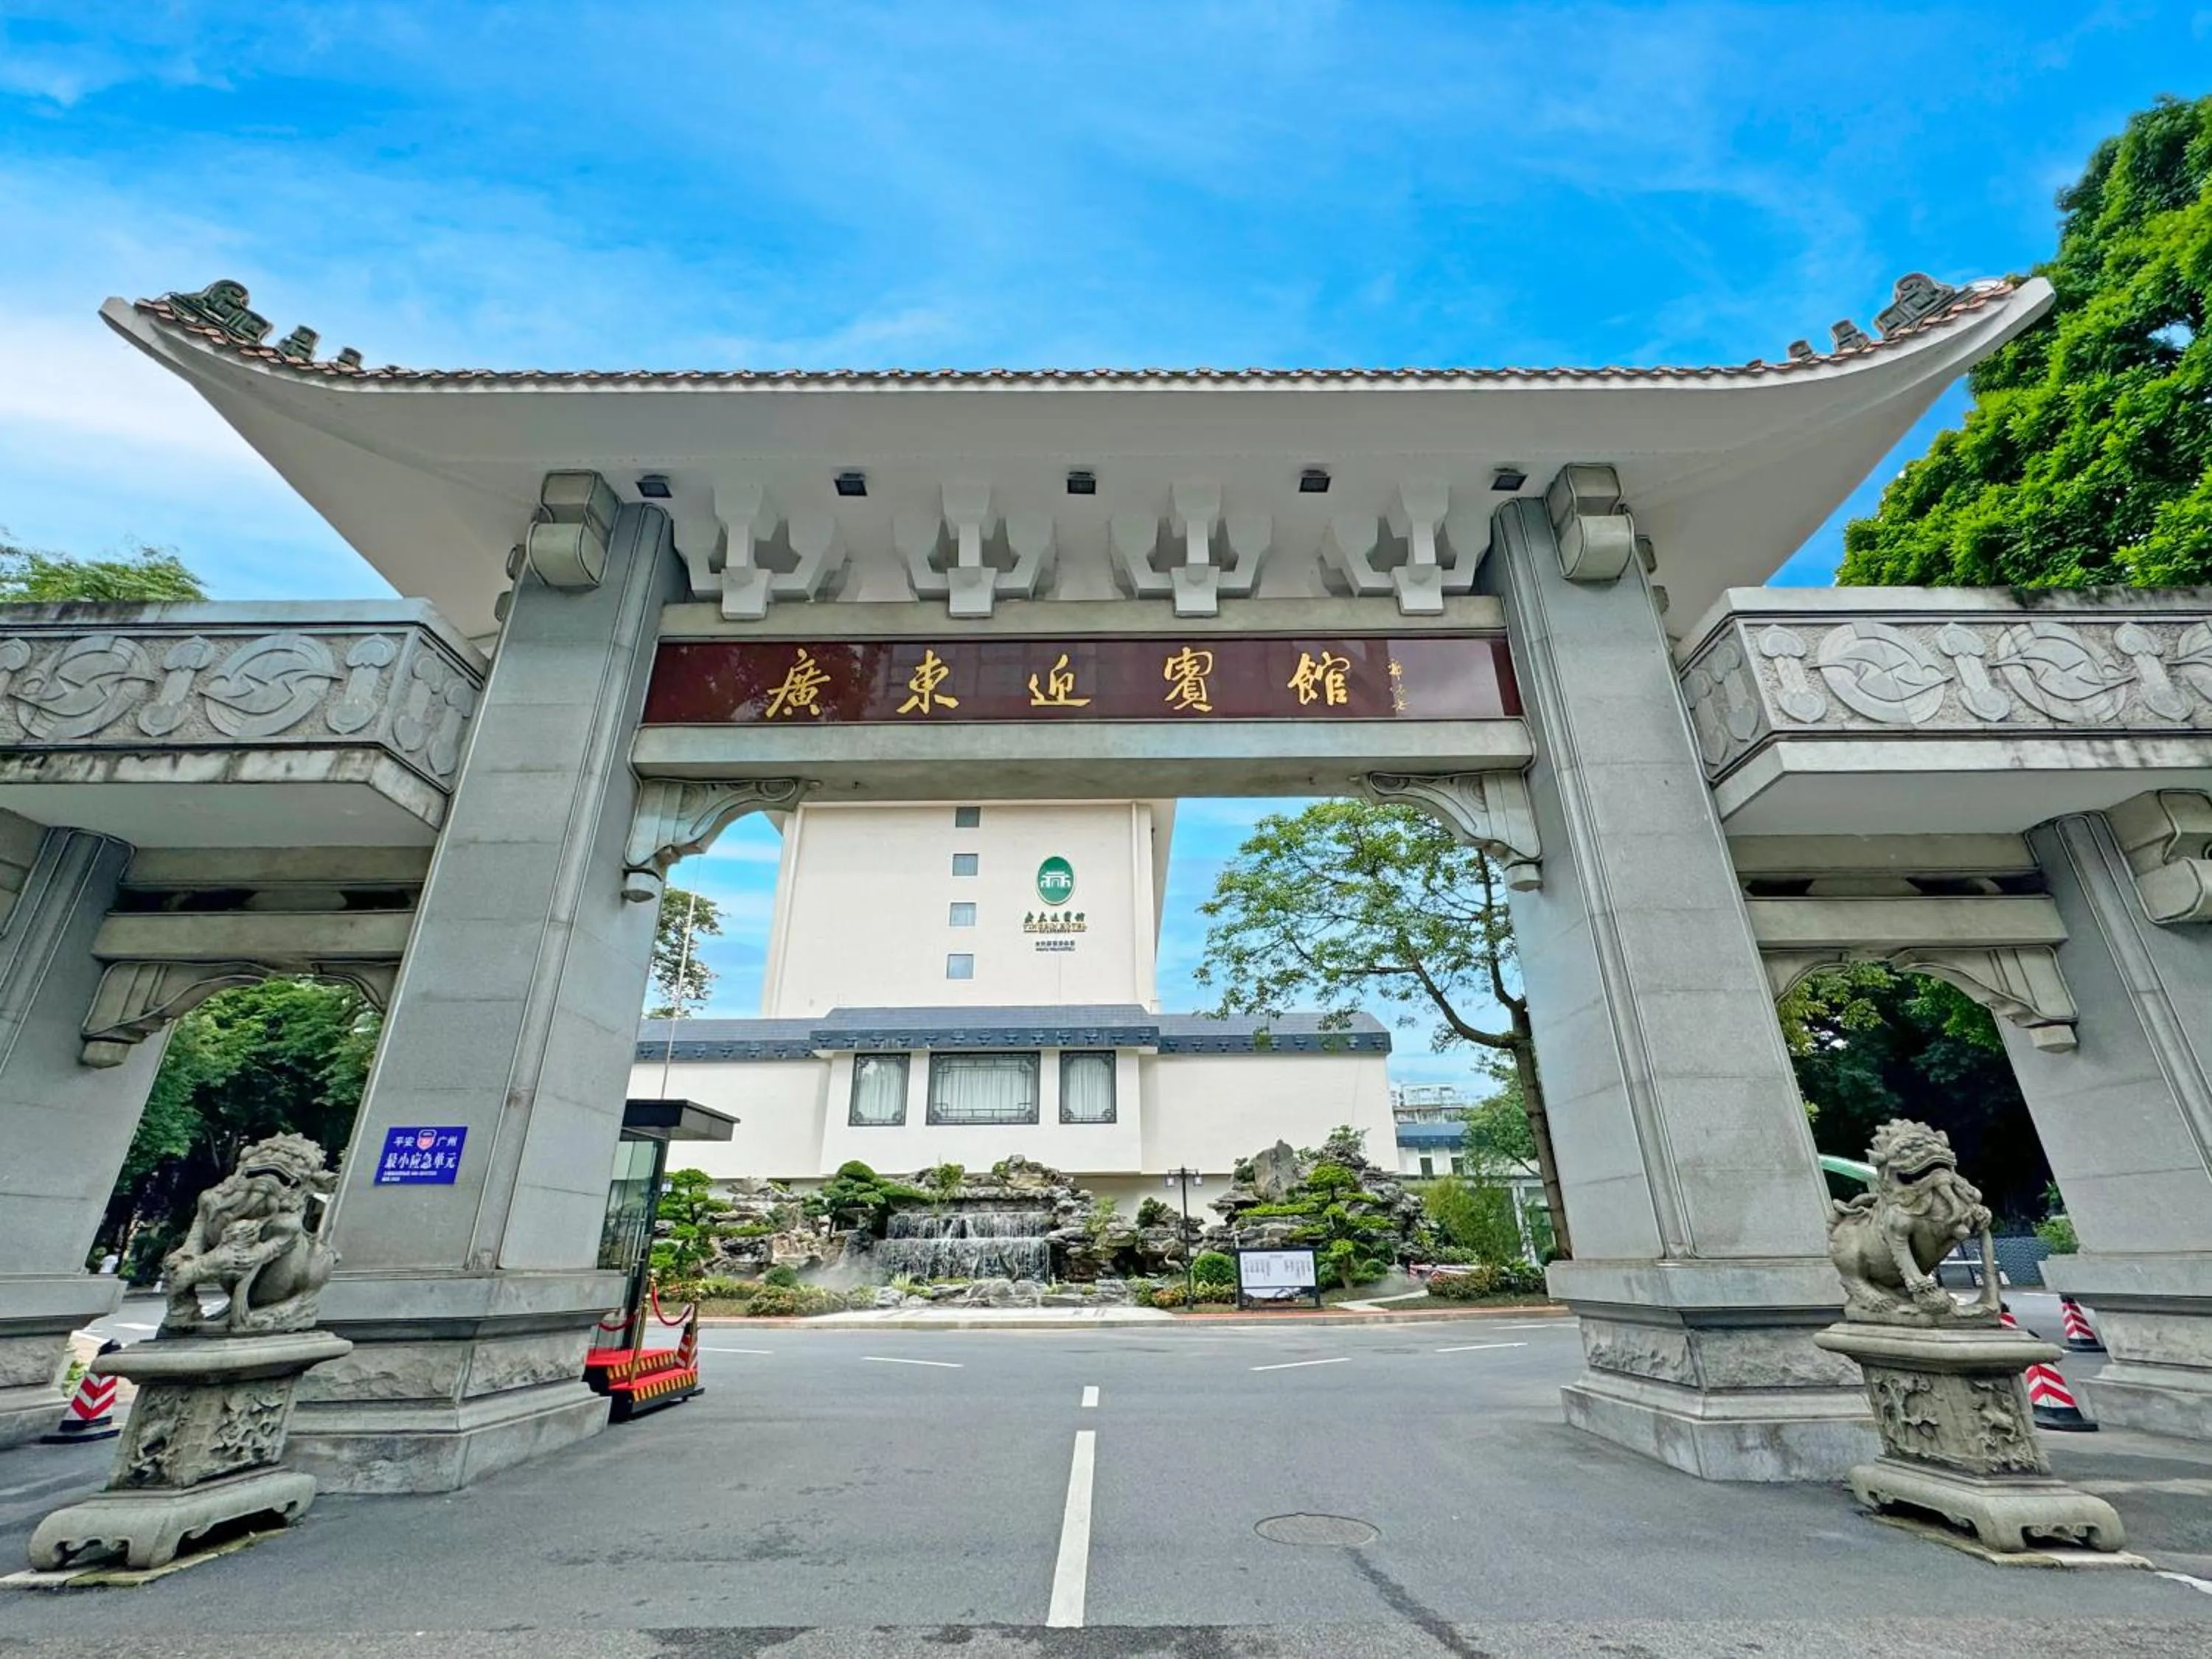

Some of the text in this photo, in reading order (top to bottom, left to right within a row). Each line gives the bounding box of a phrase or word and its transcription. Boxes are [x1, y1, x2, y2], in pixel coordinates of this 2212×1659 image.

[765, 647, 1350, 718] 廣東迎賓館
[393, 1136, 457, 1147] 平安 广州
[384, 1152, 456, 1169] 最小应急单元
